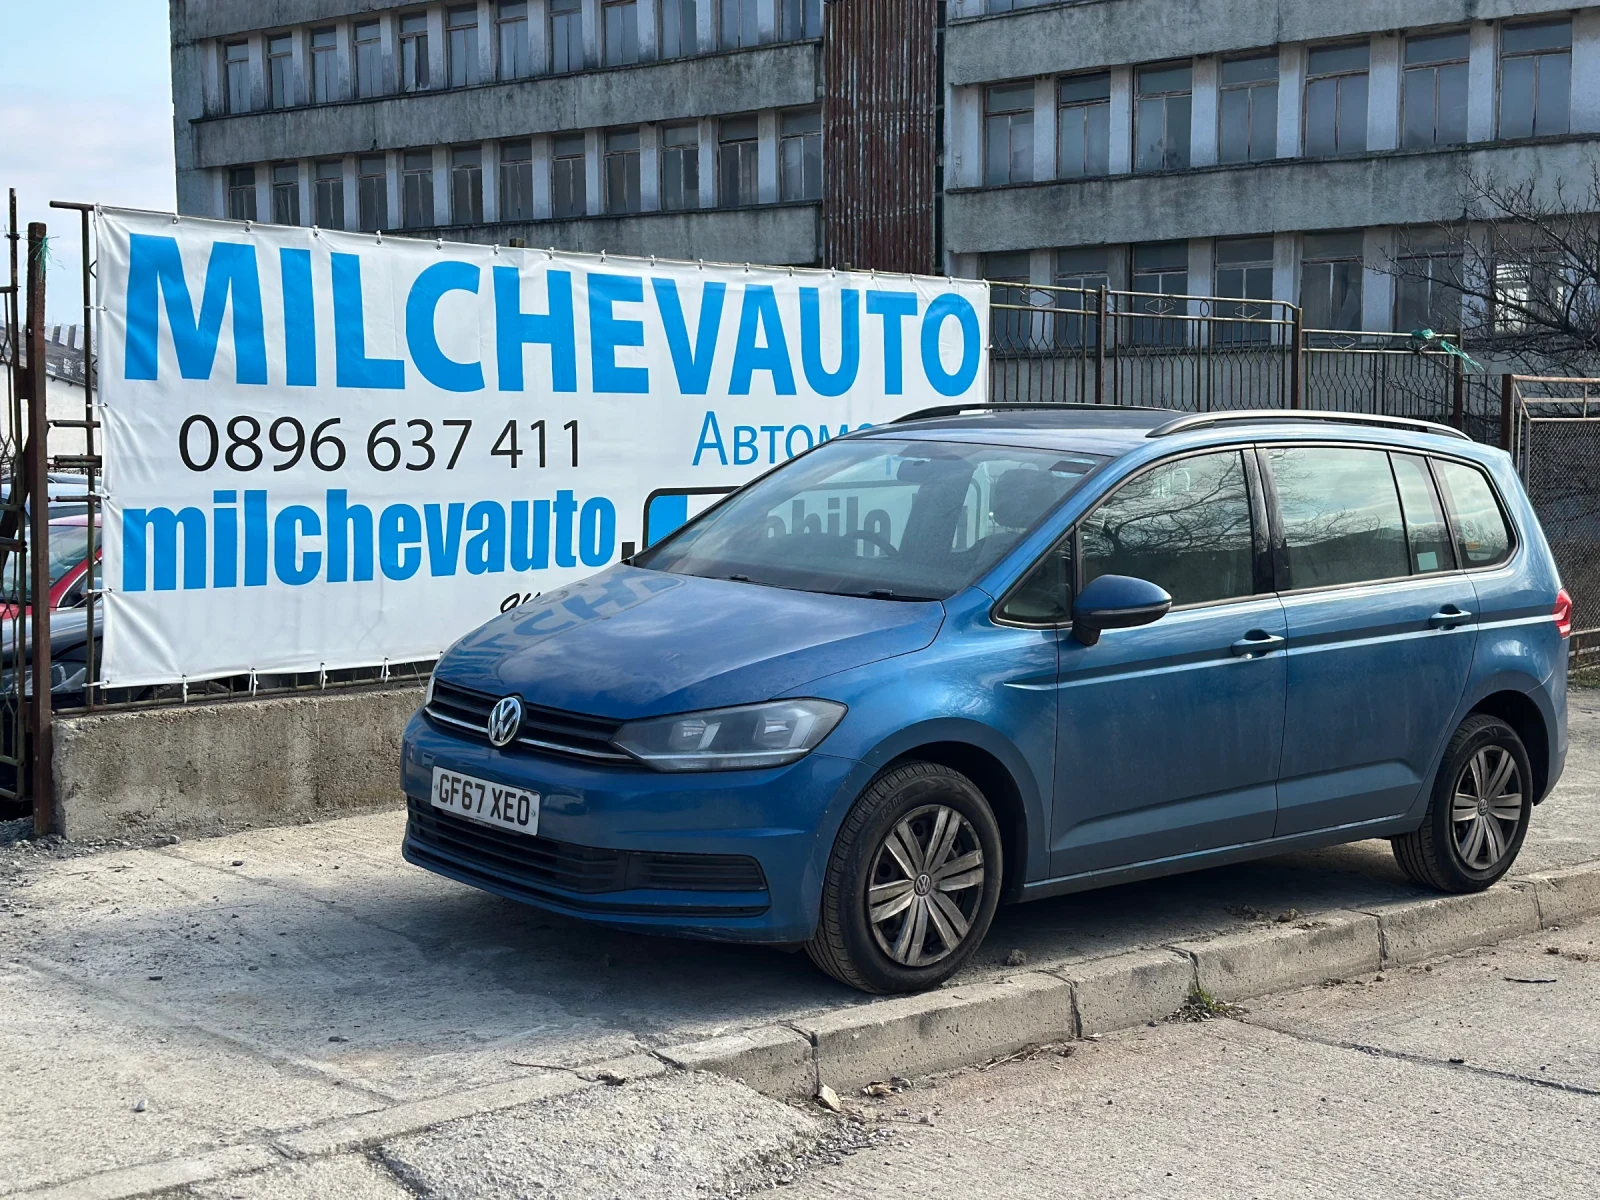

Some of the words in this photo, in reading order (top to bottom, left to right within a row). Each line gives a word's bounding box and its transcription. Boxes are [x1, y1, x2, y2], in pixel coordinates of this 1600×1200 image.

[124, 233, 981, 397] MILCHEVAUTO
[178, 414, 347, 472] 0896
[366, 419, 473, 472] 637
[490, 419, 580, 469] 411
[439, 773, 486, 814] GF67
[490, 787, 531, 827] XEO
